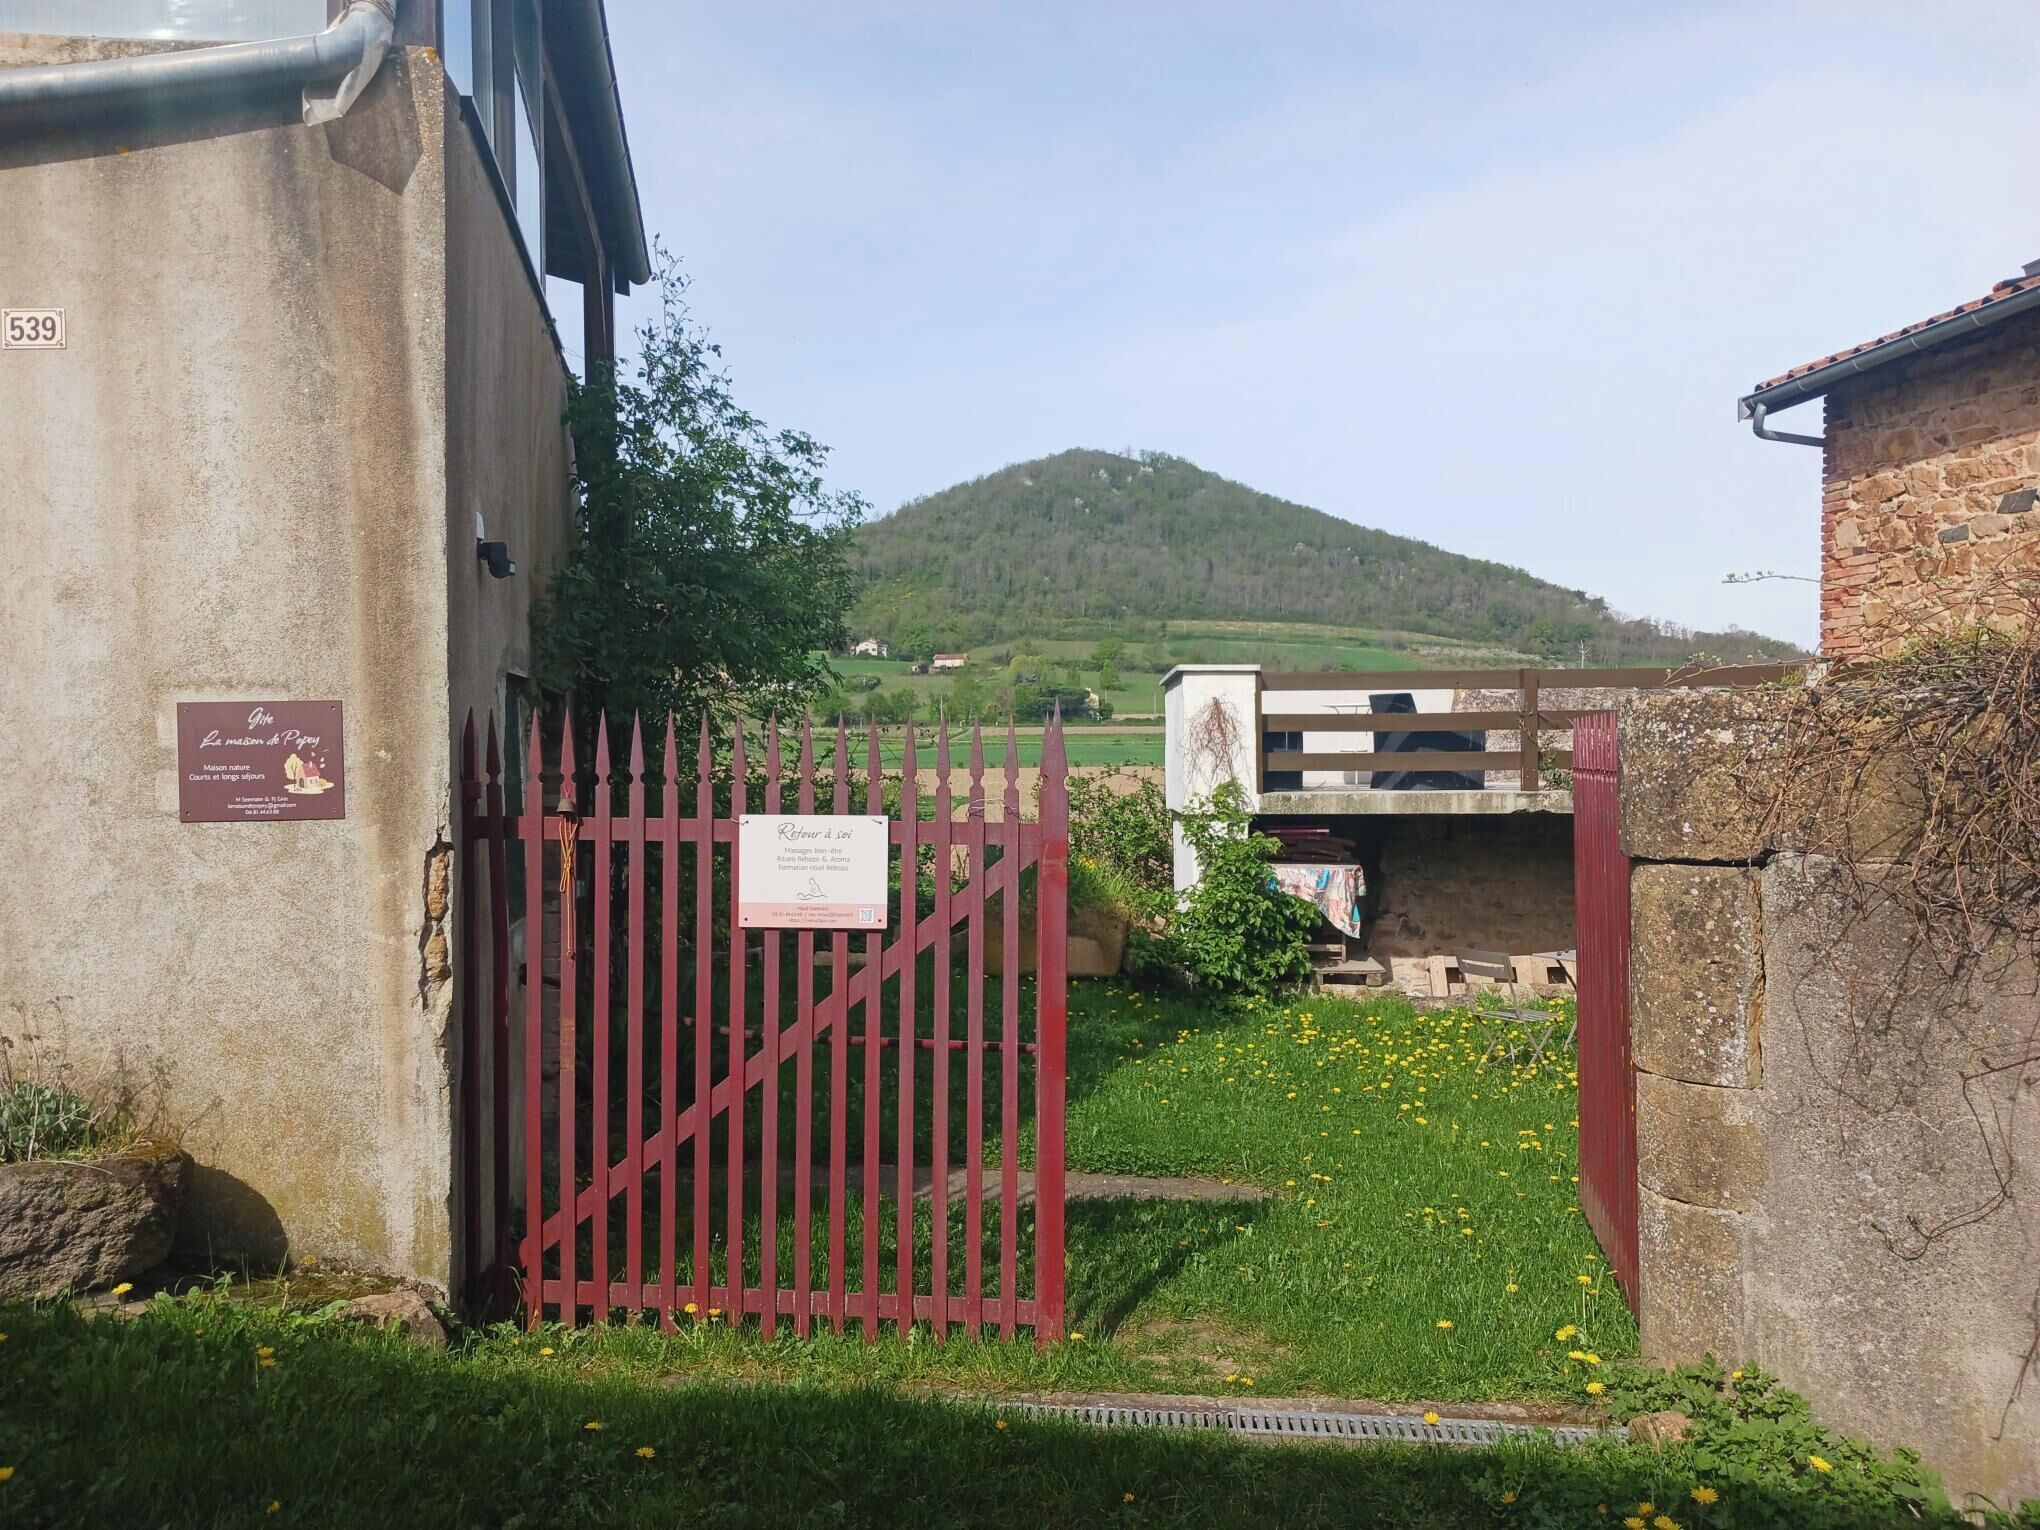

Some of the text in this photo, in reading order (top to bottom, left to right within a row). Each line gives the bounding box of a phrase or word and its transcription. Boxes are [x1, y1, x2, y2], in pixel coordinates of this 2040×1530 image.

[10, 316, 56, 341] 539
[200, 729, 320, 750] La maison de Popey
[189, 772, 265, 782] Courts et longs séjours
[777, 822, 853, 841] Retour à soi
[784, 847, 813, 855] Massages
[776, 855, 796, 863] Rituels
[797, 855, 820, 863] Rebozo
[821, 855, 828, 863] &
